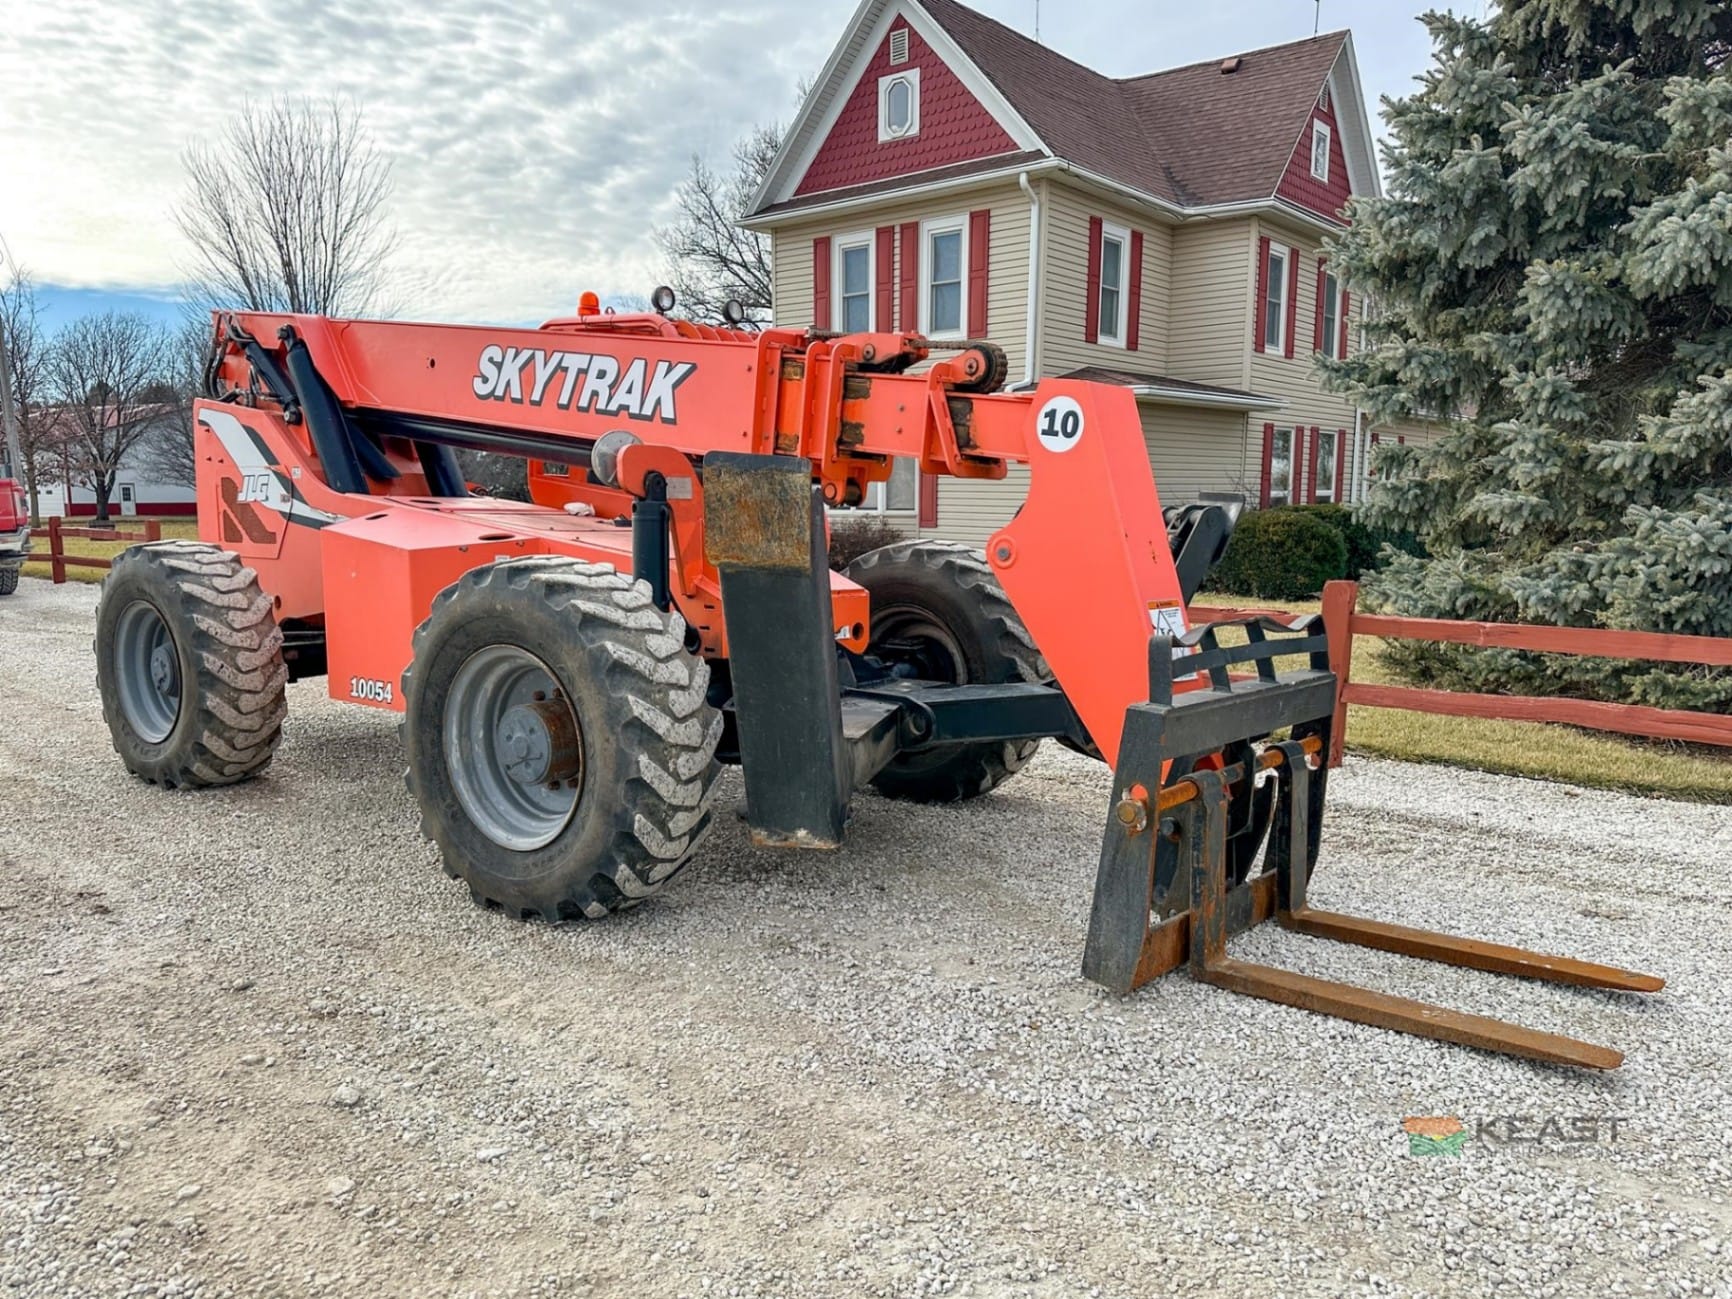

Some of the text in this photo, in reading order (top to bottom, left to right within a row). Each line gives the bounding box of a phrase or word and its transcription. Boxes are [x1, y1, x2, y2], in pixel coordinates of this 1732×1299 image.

[472, 344, 697, 425] SKYTRAK
[1041, 408, 1080, 439] 10
[237, 474, 270, 503] JLG
[350, 676, 393, 704] 10054
